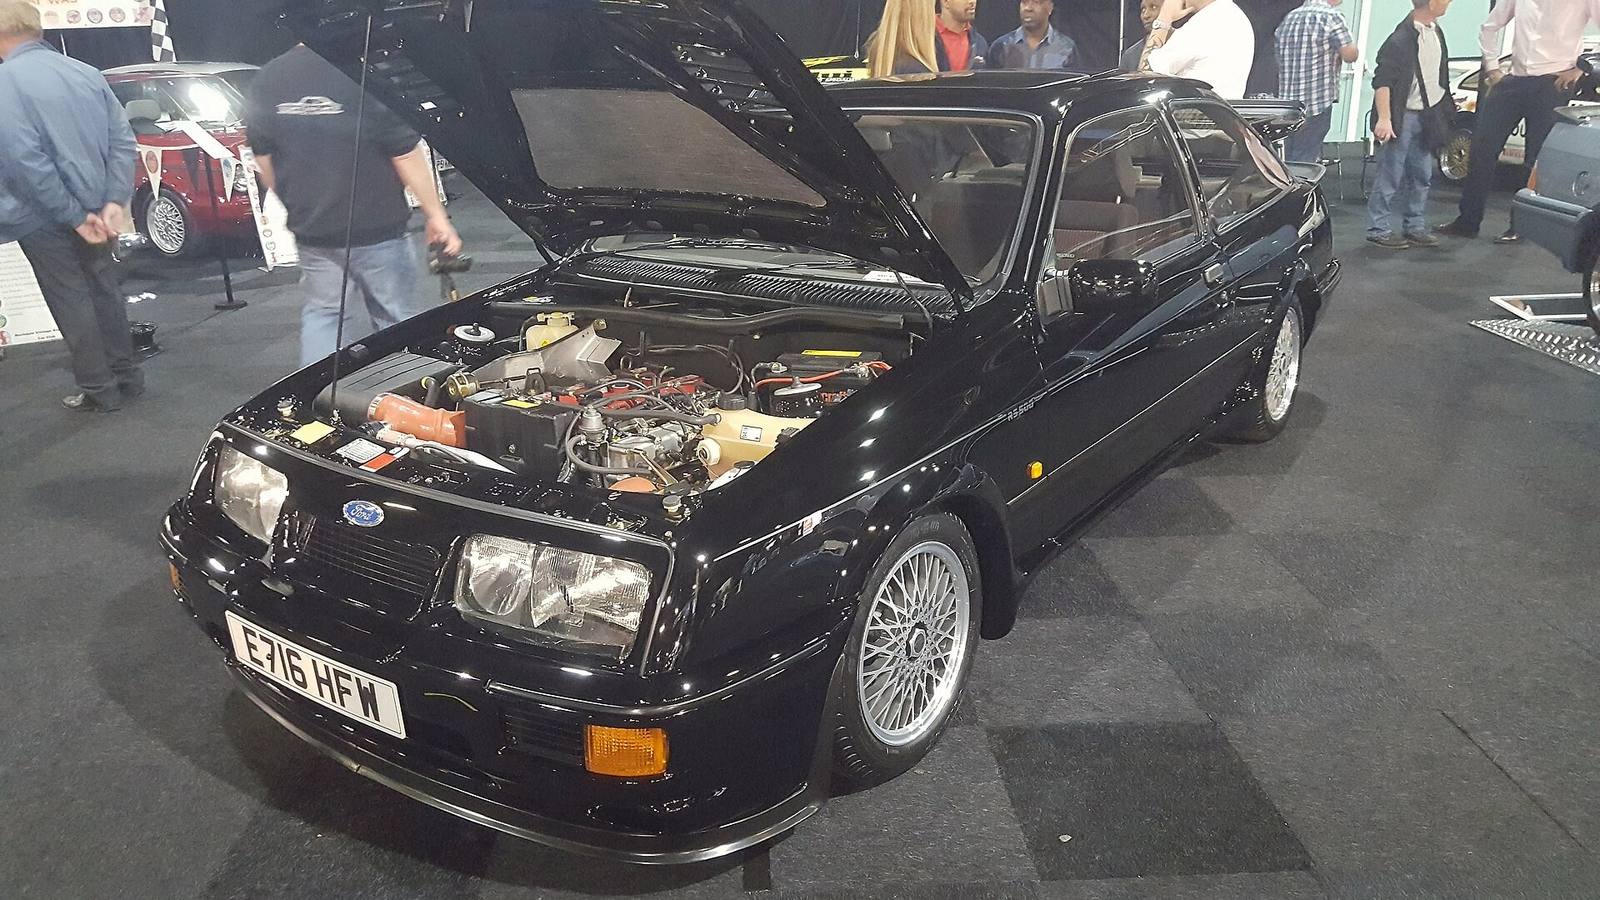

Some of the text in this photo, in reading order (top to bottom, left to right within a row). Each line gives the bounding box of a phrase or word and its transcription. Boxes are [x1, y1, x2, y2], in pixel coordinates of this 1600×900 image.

[1008, 398, 1035, 421] RS500
[351, 505, 374, 520] Ford
[242, 625, 380, 722] E716 HFW
